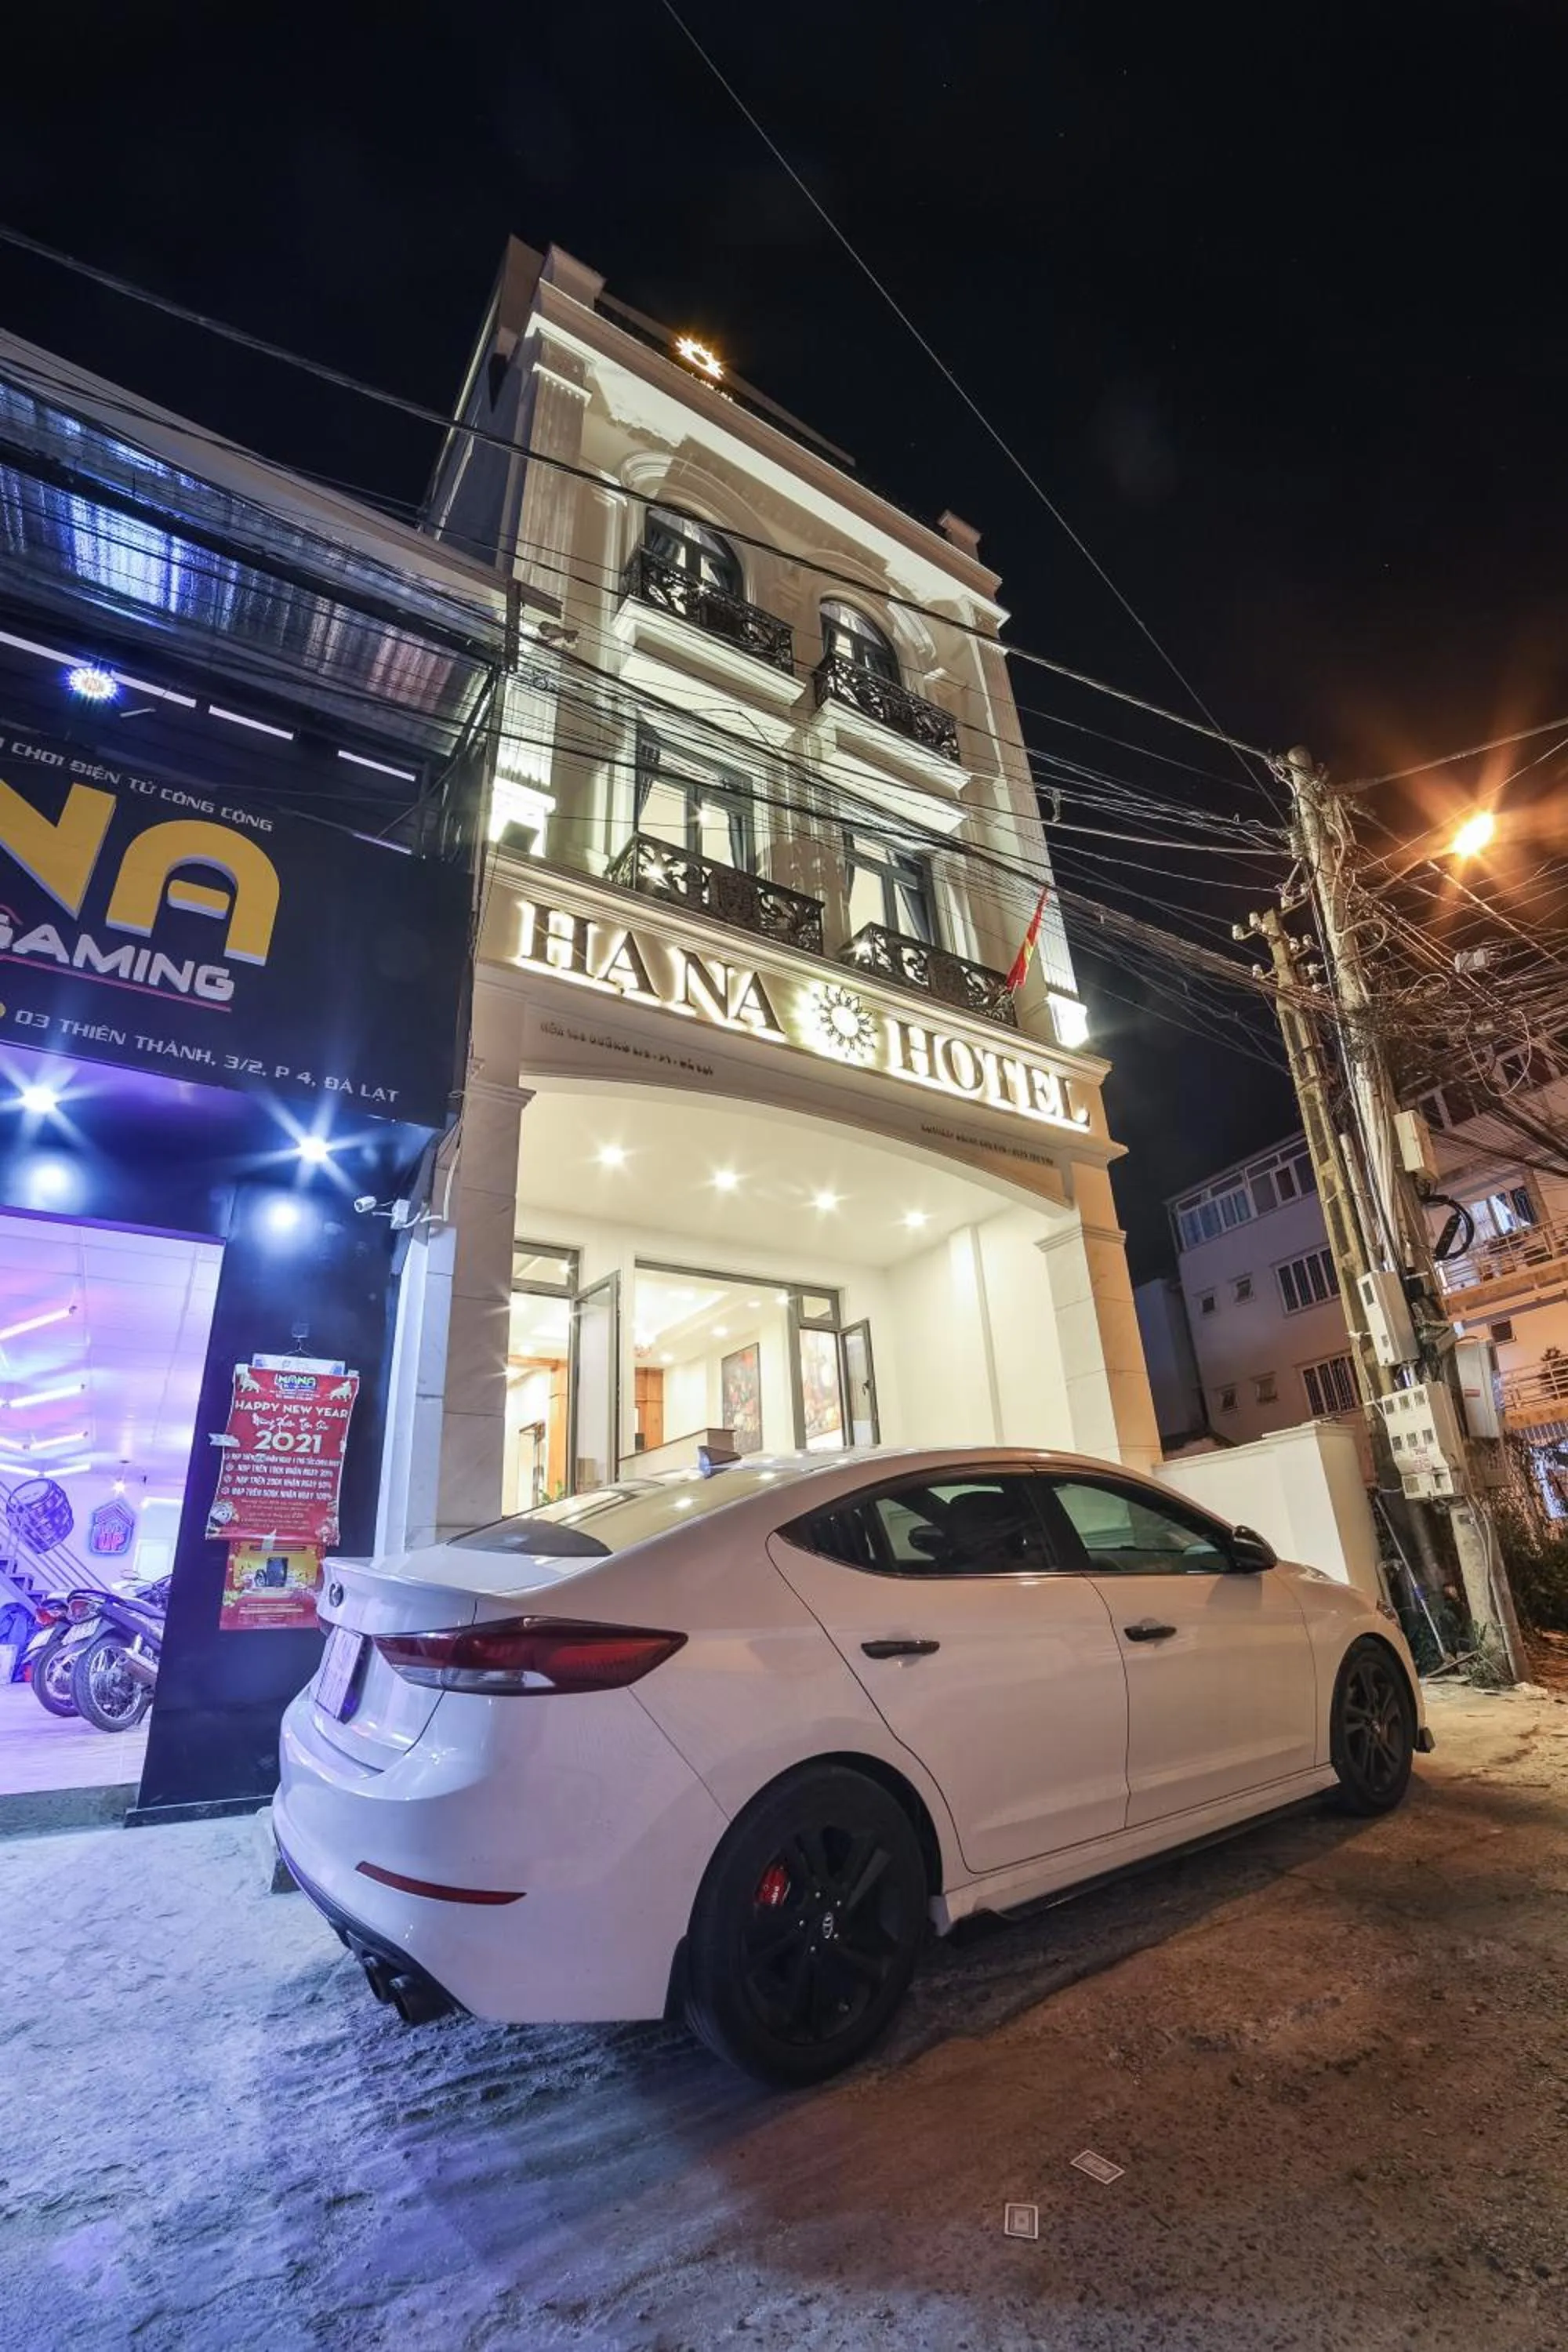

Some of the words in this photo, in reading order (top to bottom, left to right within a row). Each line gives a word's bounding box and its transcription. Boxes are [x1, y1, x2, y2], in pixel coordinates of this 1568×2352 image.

[15, 1009, 51, 1029] 03
[59, 1018, 127, 1046] THIÊN
[274, 1065, 290, 1079] P
[360, 1083, 400, 1103] LẠT
[895, 1021, 1091, 1127] HOTEL
[235, 1399, 281, 1412] HAPPY
[282, 1404, 313, 1414] NEW
[315, 1406, 349, 1419] YEAR
[252, 1429, 323, 1454] 2021
